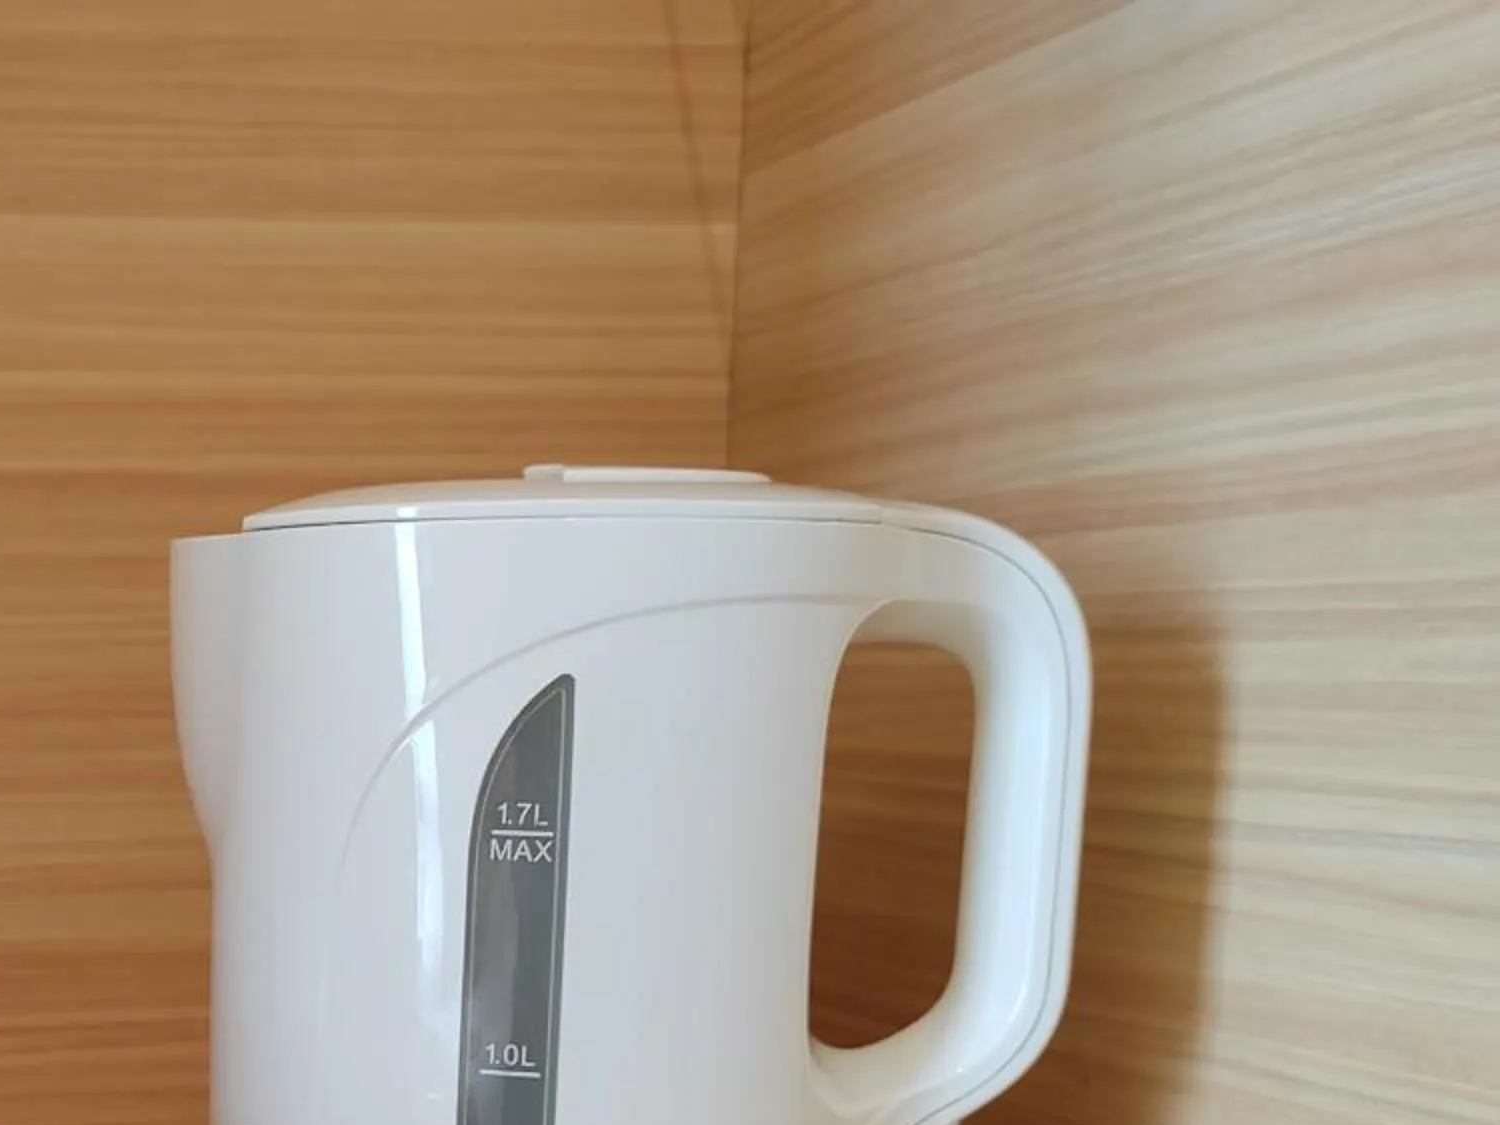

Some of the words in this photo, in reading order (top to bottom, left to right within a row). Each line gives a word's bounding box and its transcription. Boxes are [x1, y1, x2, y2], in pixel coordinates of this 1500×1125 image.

[497, 802, 549, 827] 1.7L
[489, 838, 553, 863] MAX
[485, 1043, 536, 1067] 1.0L
